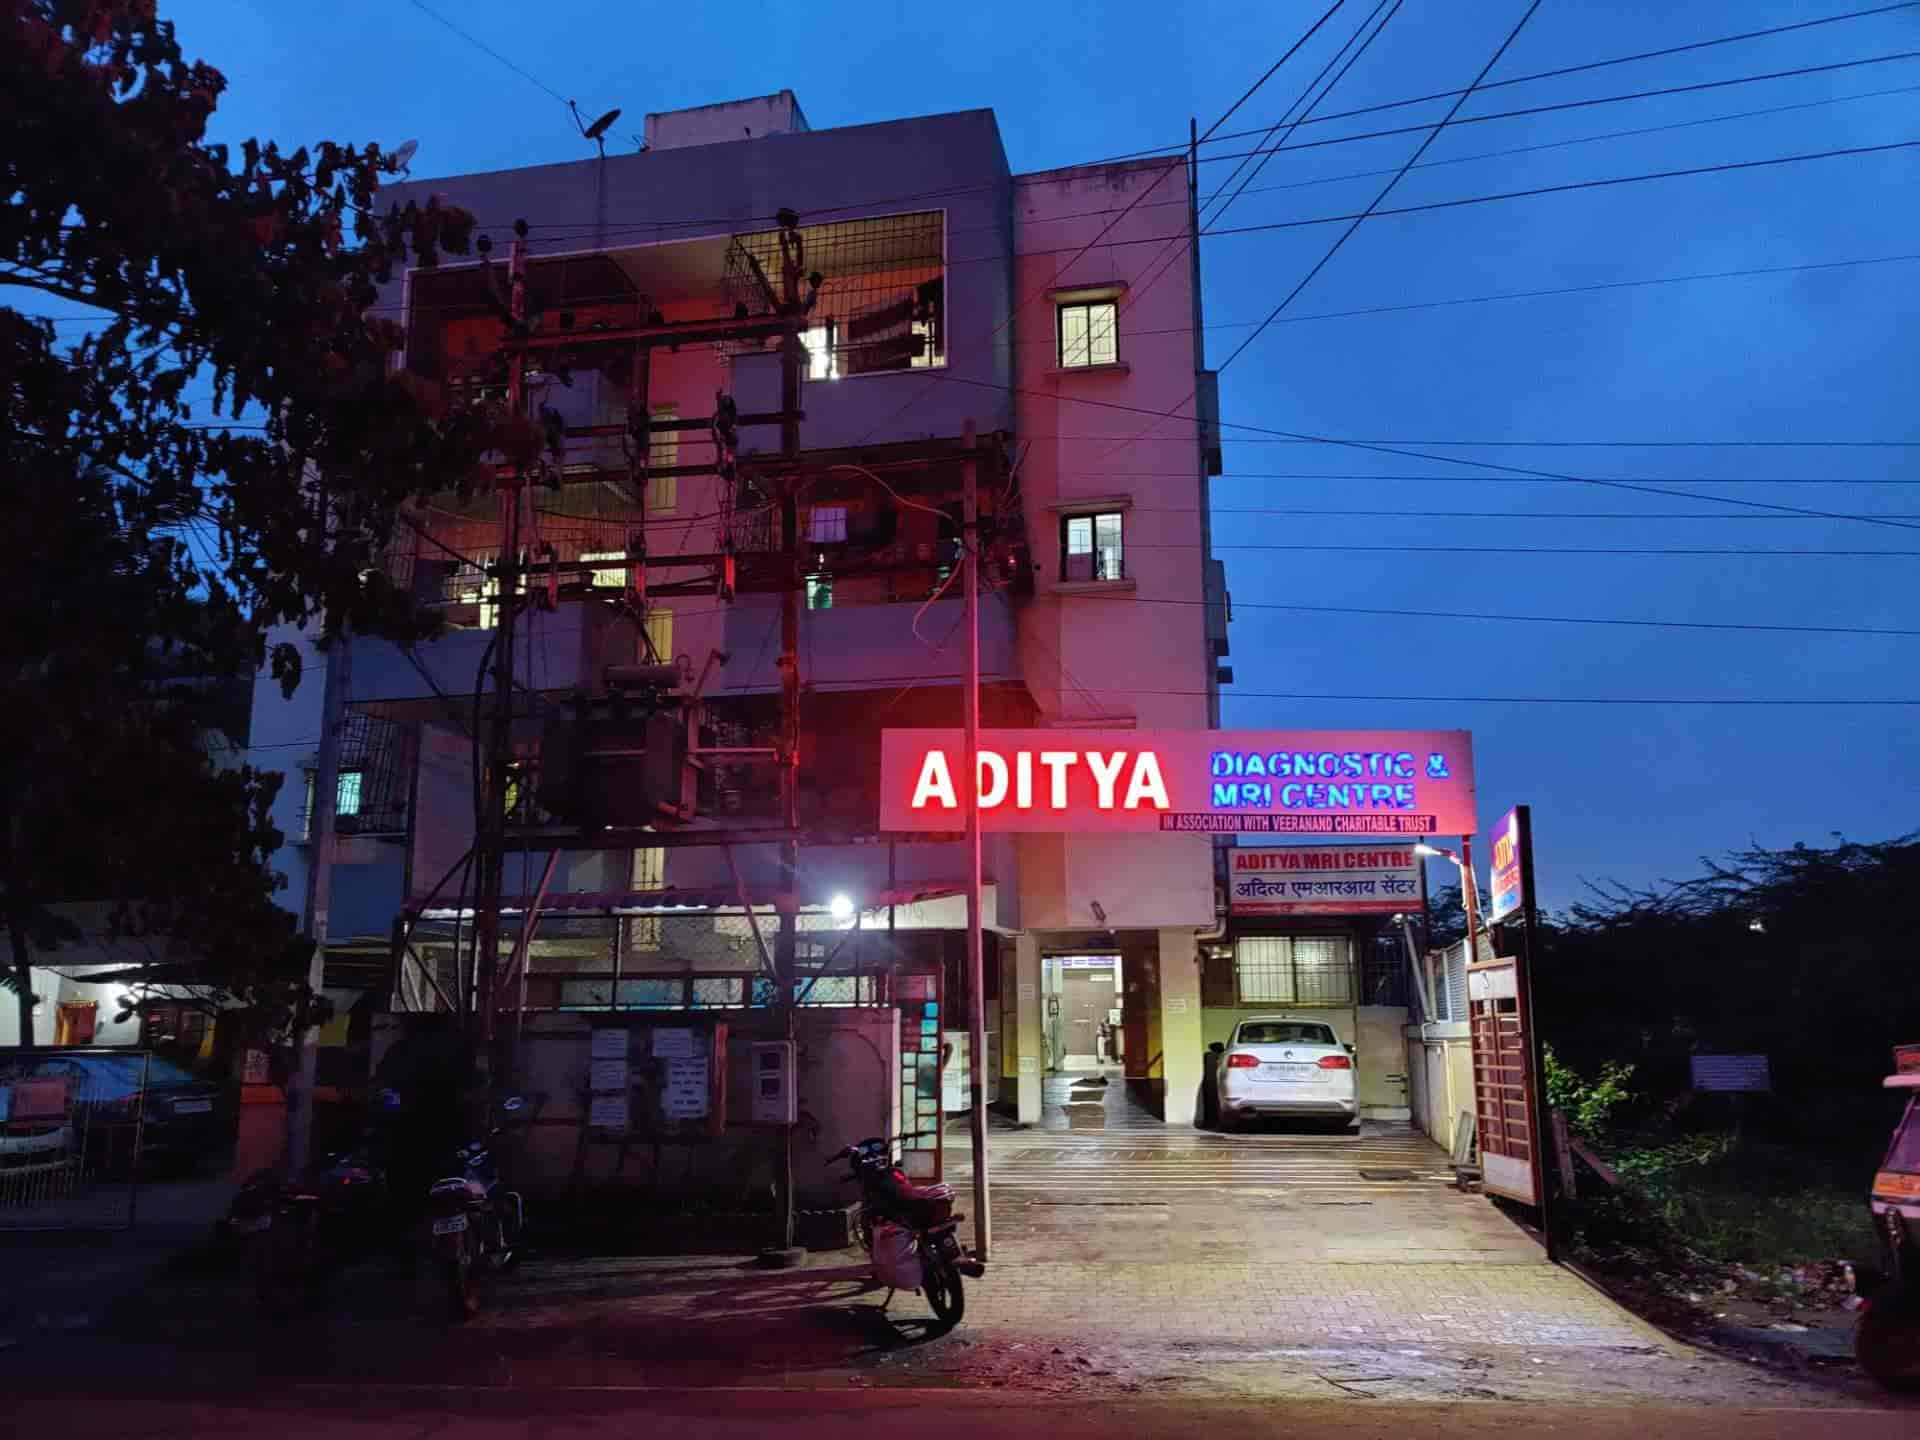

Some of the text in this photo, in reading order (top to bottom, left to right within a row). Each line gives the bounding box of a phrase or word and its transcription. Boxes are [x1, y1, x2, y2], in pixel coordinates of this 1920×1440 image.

[1211, 752, 1450, 778] DIAGNOSTIC &
[911, 750, 1170, 809] ADITYA
[1211, 783, 1416, 808] MRI CENTRE
[1163, 816, 1432, 831] IN ASSOCIATION WITH VEERANAND CHARITABLE TRUST
[1236, 850, 1413, 869] ADITYA MRI CENTRE
